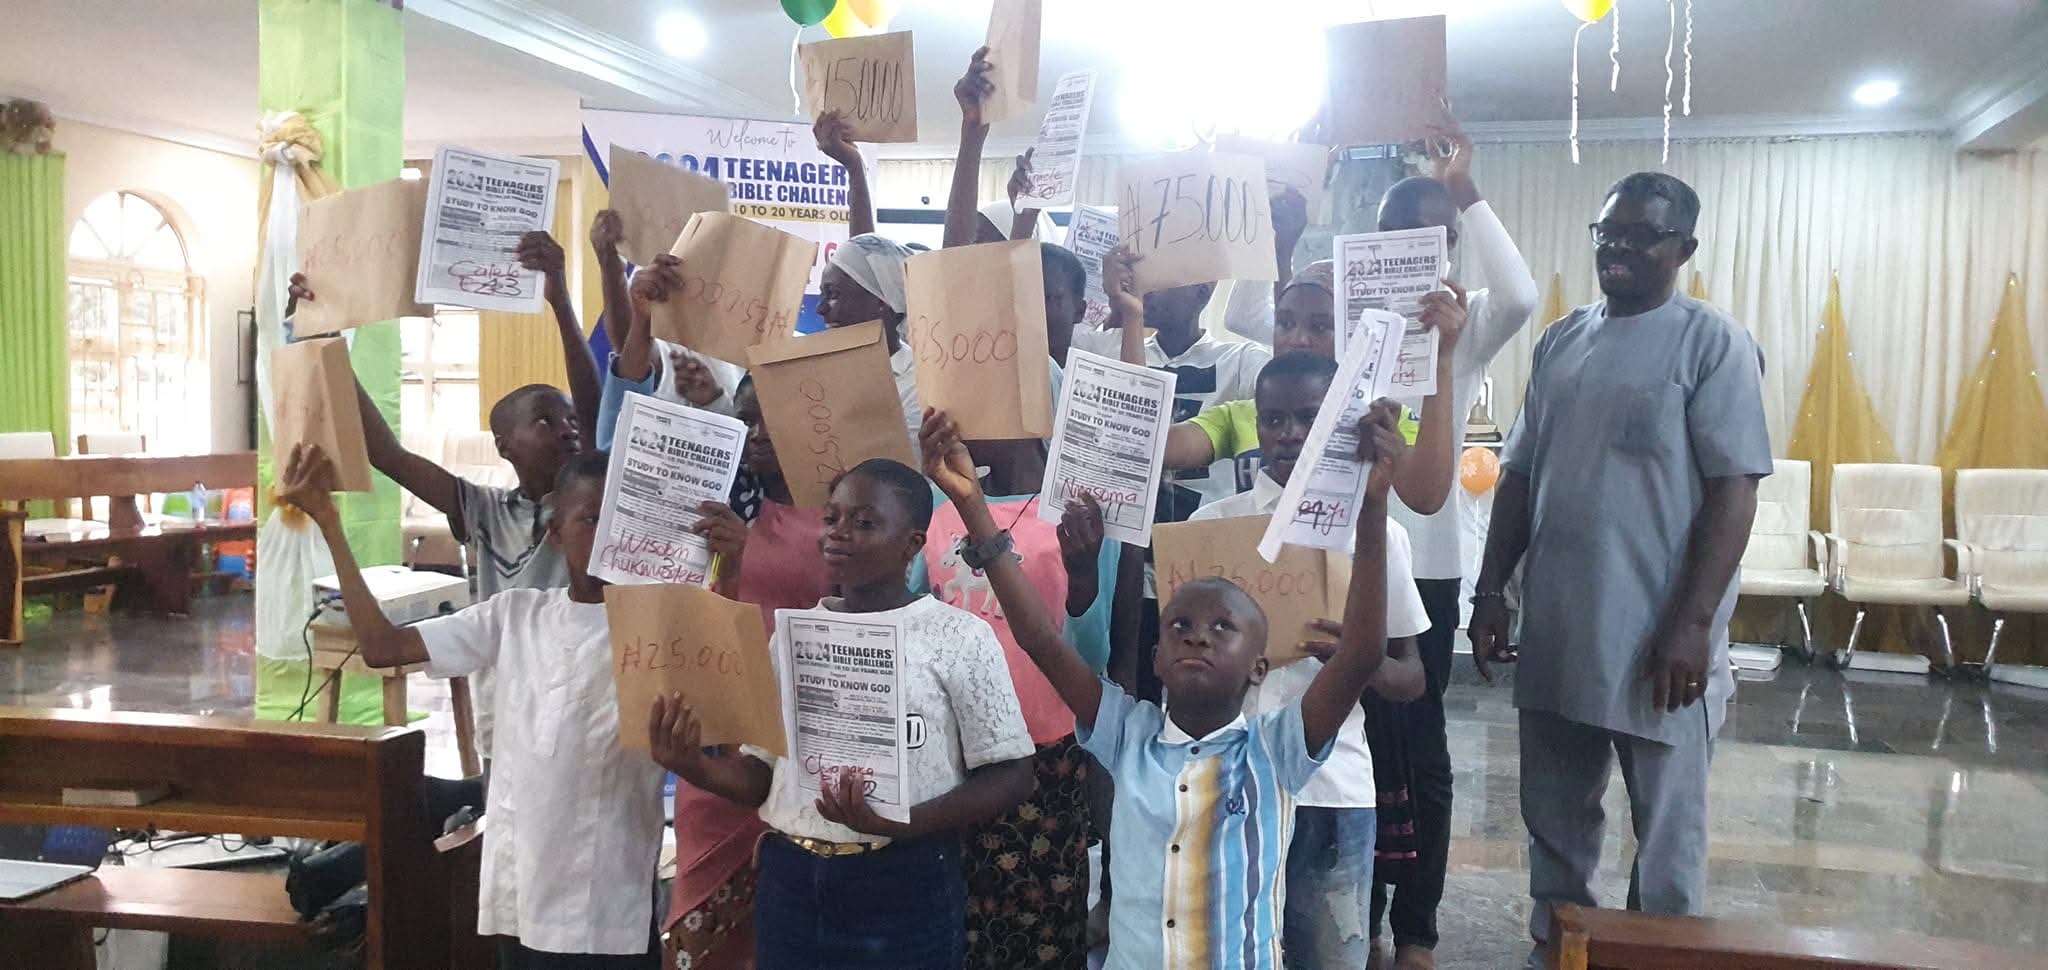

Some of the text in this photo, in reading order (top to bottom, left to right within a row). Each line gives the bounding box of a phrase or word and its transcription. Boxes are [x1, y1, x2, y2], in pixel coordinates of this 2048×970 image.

[706, 121, 778, 151] Welcome
[725, 157, 851, 187] TEENAGER
[729, 182, 851, 207] BIBLE CHALLEN
[446, 196, 538, 218] STUDY TO KNOW GOD
[751, 206, 767, 216] TO
[772, 207, 785, 217] 20
[789, 208, 825, 220] YEARS
[1379, 286, 1390, 295] TO
[1070, 409, 1150, 438] STUDY TO KNOW GOD
[667, 446, 690, 461] BIBLE
[627, 457, 722, 492] STUDY TO KNOW GOD
[832, 655, 894, 669] BIBLE CHALLENGE
[799, 674, 891, 694] STUDY TO KNOW GOD
